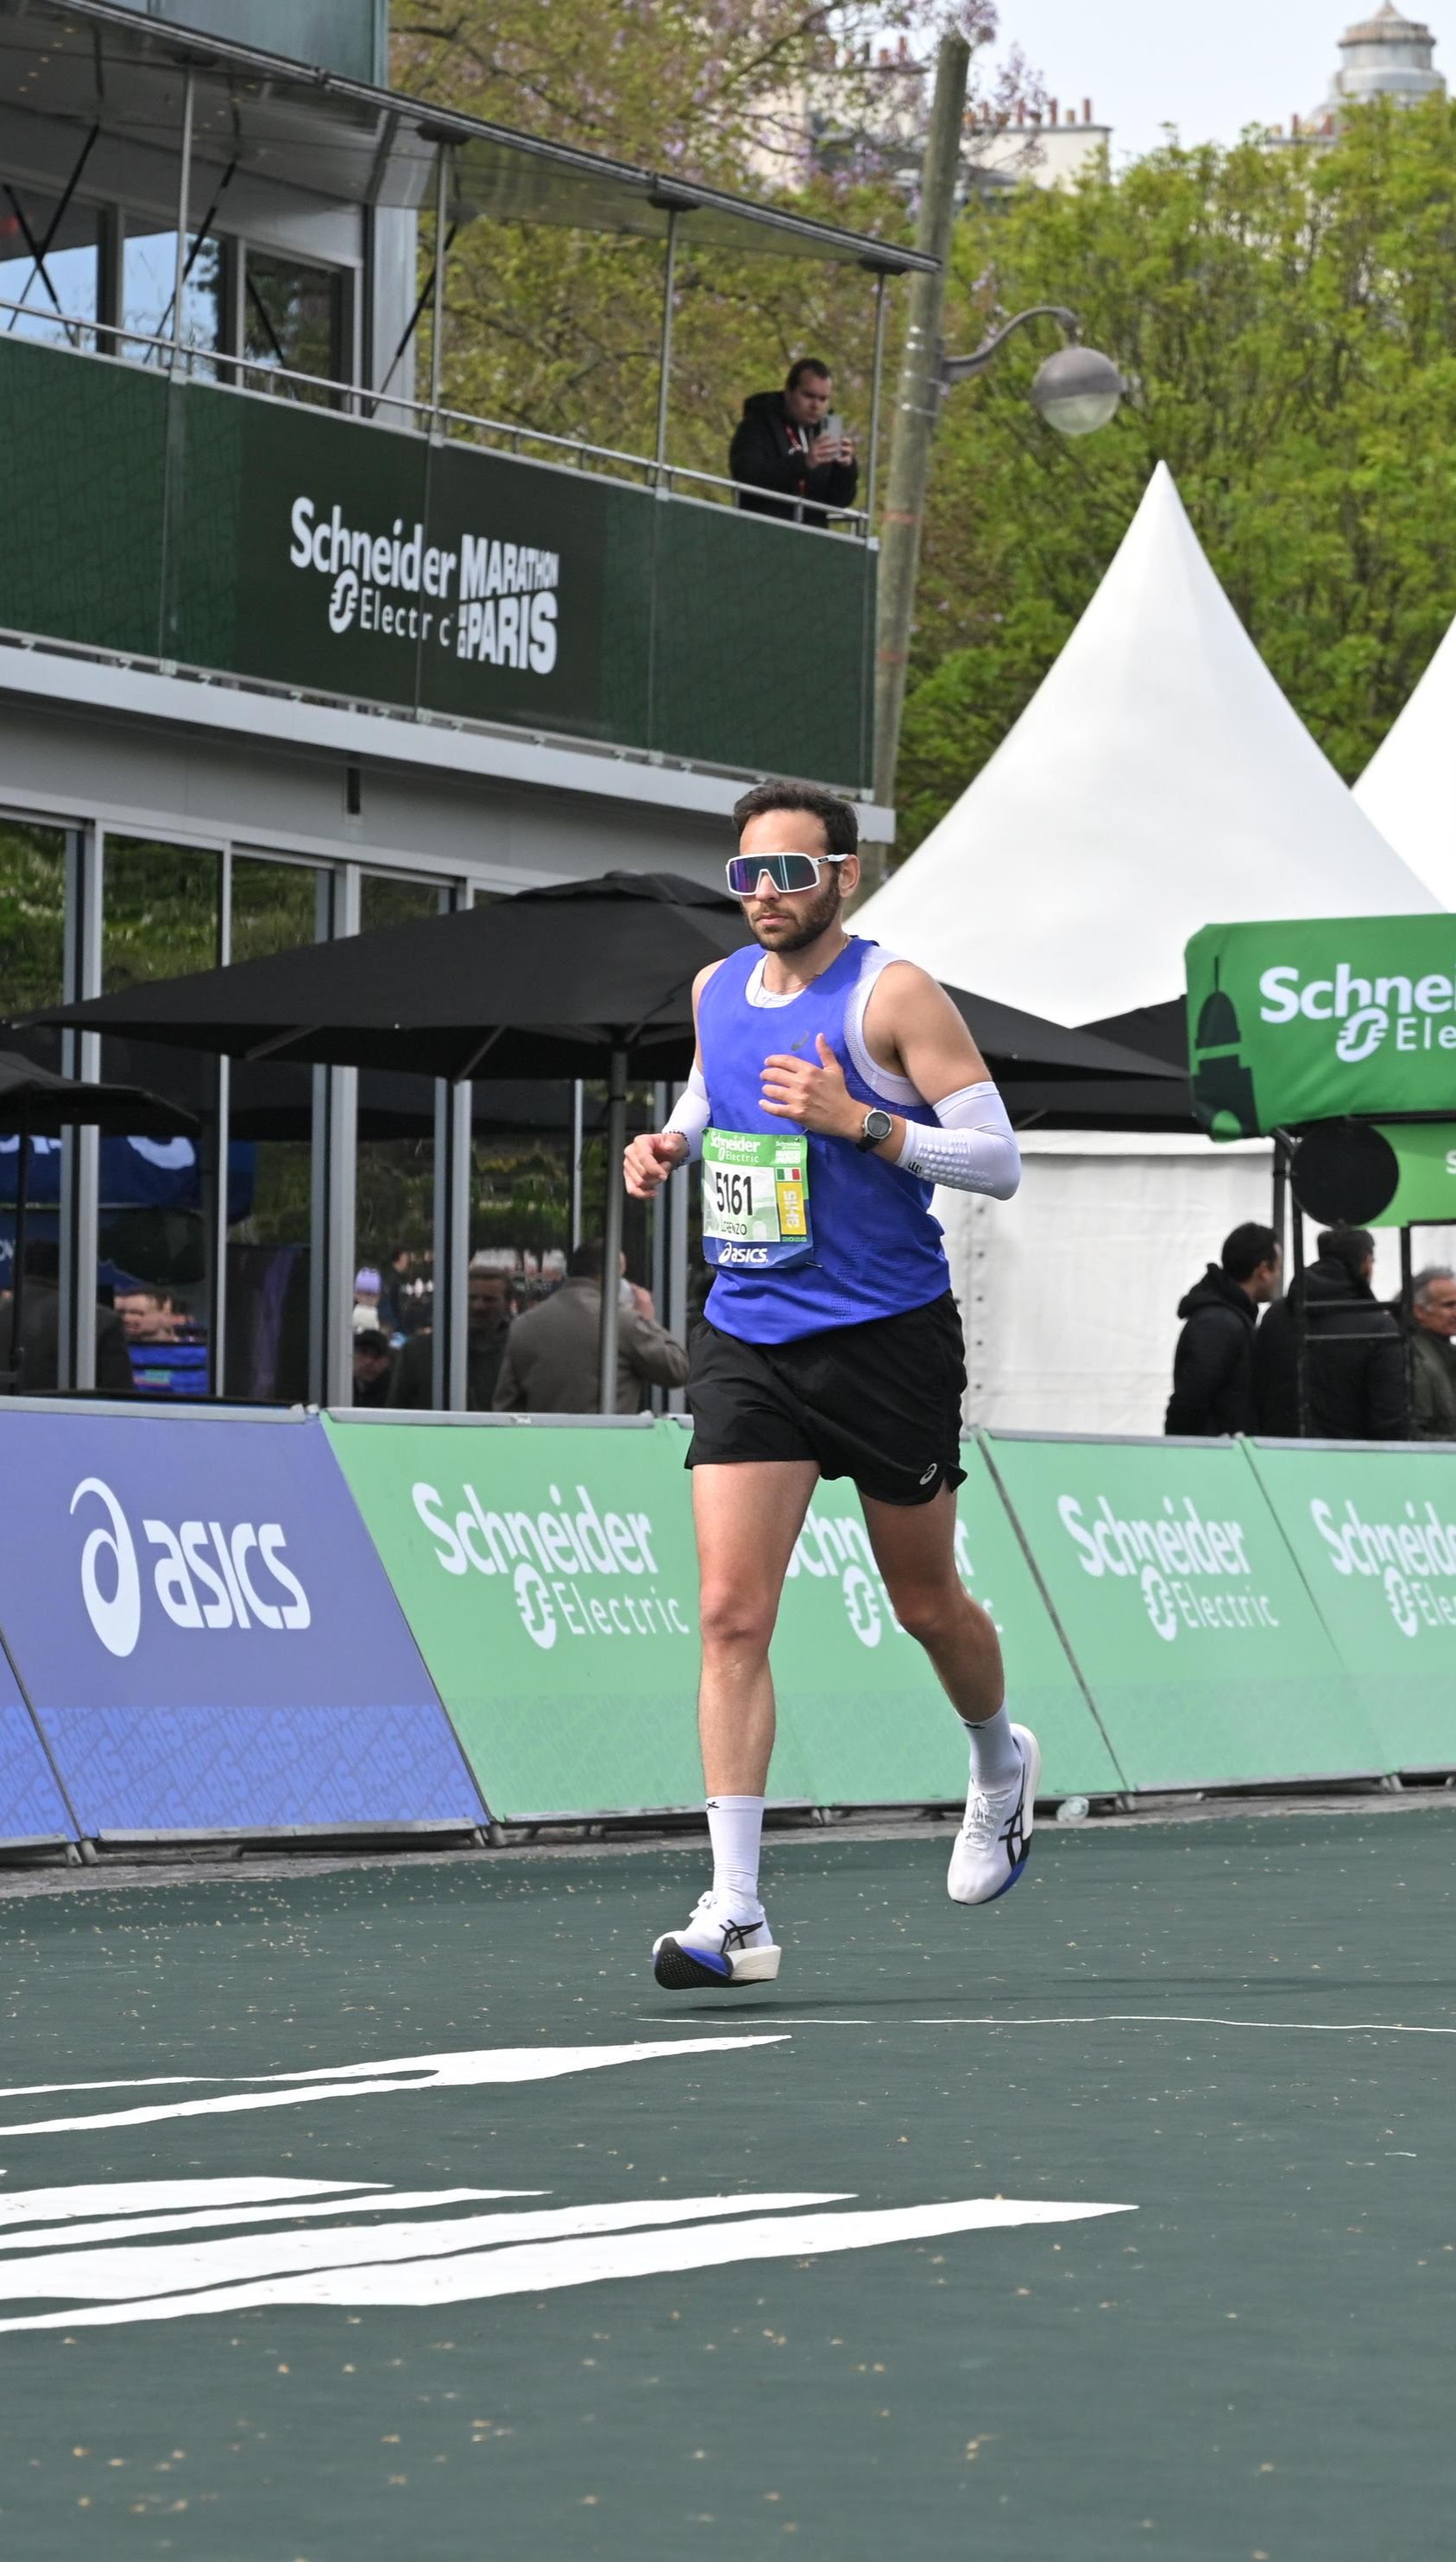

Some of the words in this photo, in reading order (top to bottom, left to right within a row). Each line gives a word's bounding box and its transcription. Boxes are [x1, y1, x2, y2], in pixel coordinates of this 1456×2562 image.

[290, 496, 456, 598] Schneider
[459, 533, 559, 601] MARATHON
[359, 587, 451, 647] Electrc
[466, 590, 558, 674] PARIS
[1258, 962, 1456, 1024] Schne
[710, 1130, 760, 1153] Schneider
[715, 1171, 753, 1216] 5161
[412, 1482, 659, 1575] Schneider
[1057, 1494, 1251, 1577] Schneider
[551, 1581, 690, 1635] Electric
[1169, 1581, 1279, 1629] Electric
